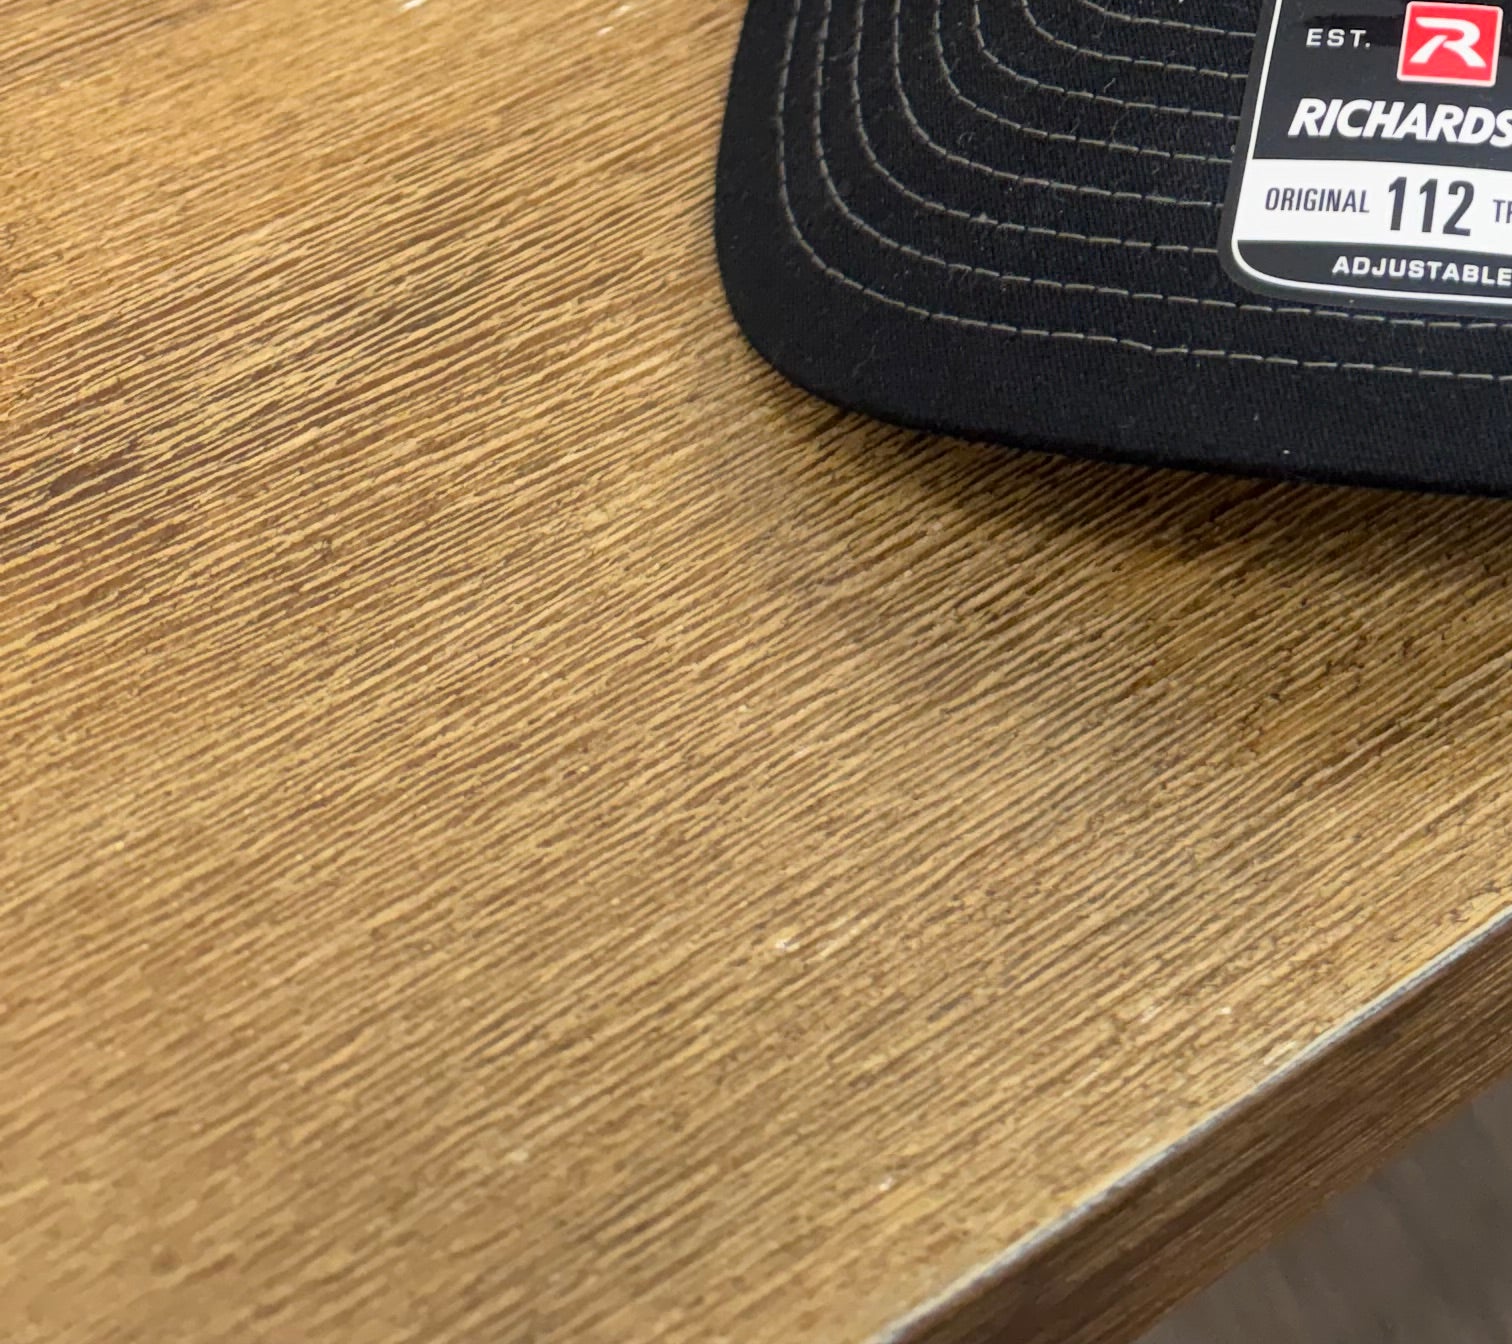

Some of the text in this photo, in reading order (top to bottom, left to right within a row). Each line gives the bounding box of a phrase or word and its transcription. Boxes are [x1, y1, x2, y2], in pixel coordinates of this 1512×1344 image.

[1305, 27, 1371, 49] EST.
[1264, 186, 1370, 214] ORIGINAL
[1386, 175, 1476, 237] 112
